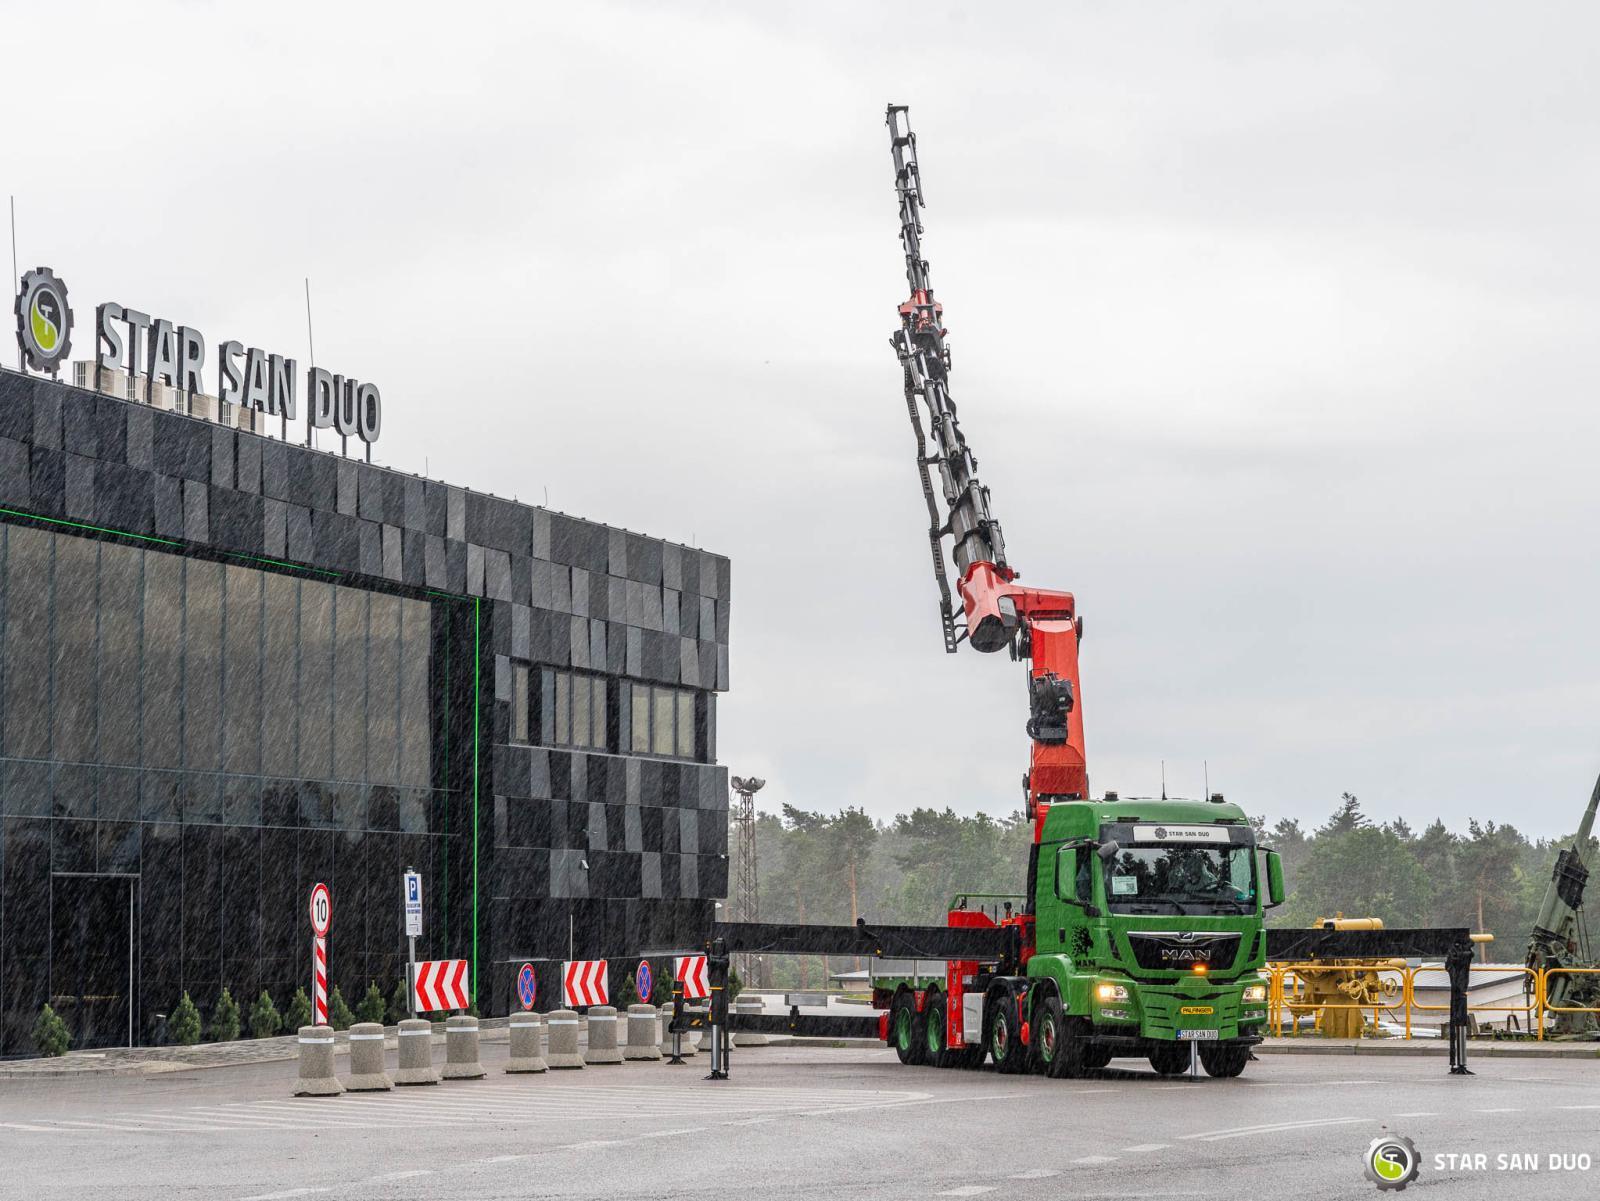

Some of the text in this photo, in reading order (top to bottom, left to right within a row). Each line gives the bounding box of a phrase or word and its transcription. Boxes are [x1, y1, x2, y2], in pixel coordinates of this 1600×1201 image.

[97, 302, 382, 443] STAR SAN DUO
[410, 880, 416, 898] P
[316, 898, 327, 922] 10
[1161, 949, 1211, 961] MAN
[1181, 1030, 1218, 1039] STAR SAN DUO
